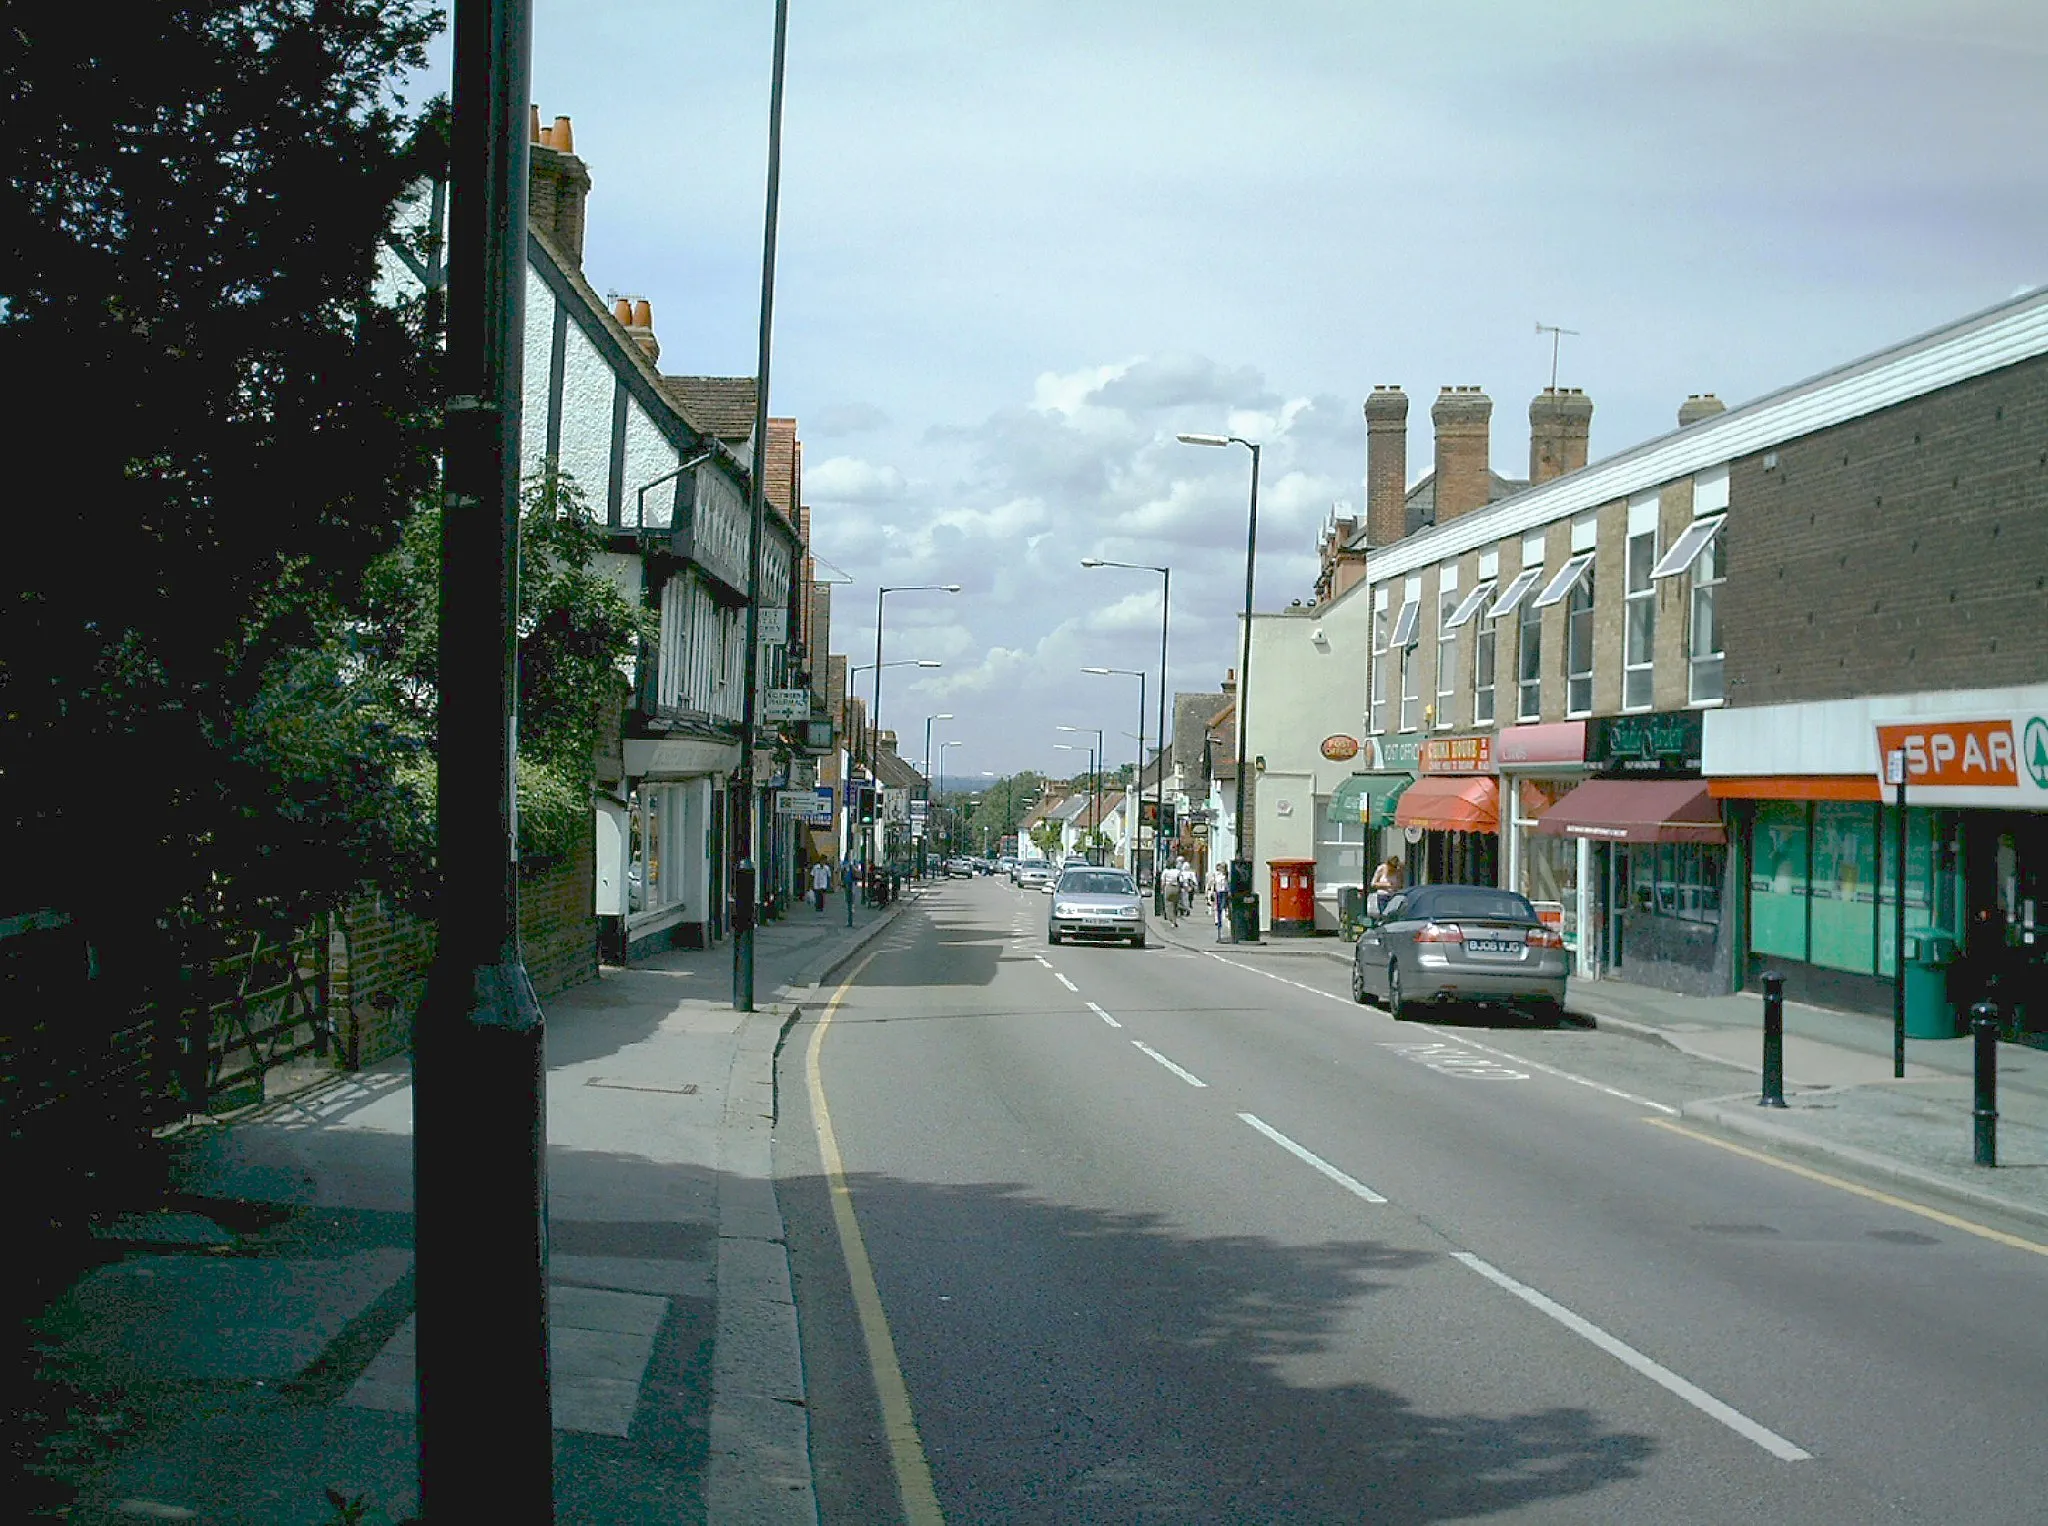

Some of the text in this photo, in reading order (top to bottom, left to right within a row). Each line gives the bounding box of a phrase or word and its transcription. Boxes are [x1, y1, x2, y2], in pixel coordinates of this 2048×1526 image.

[1328, 740, 1352, 748] POST
[1384, 743, 1419, 761] POST OFFIC
[1904, 730, 2015, 776] SPAR
